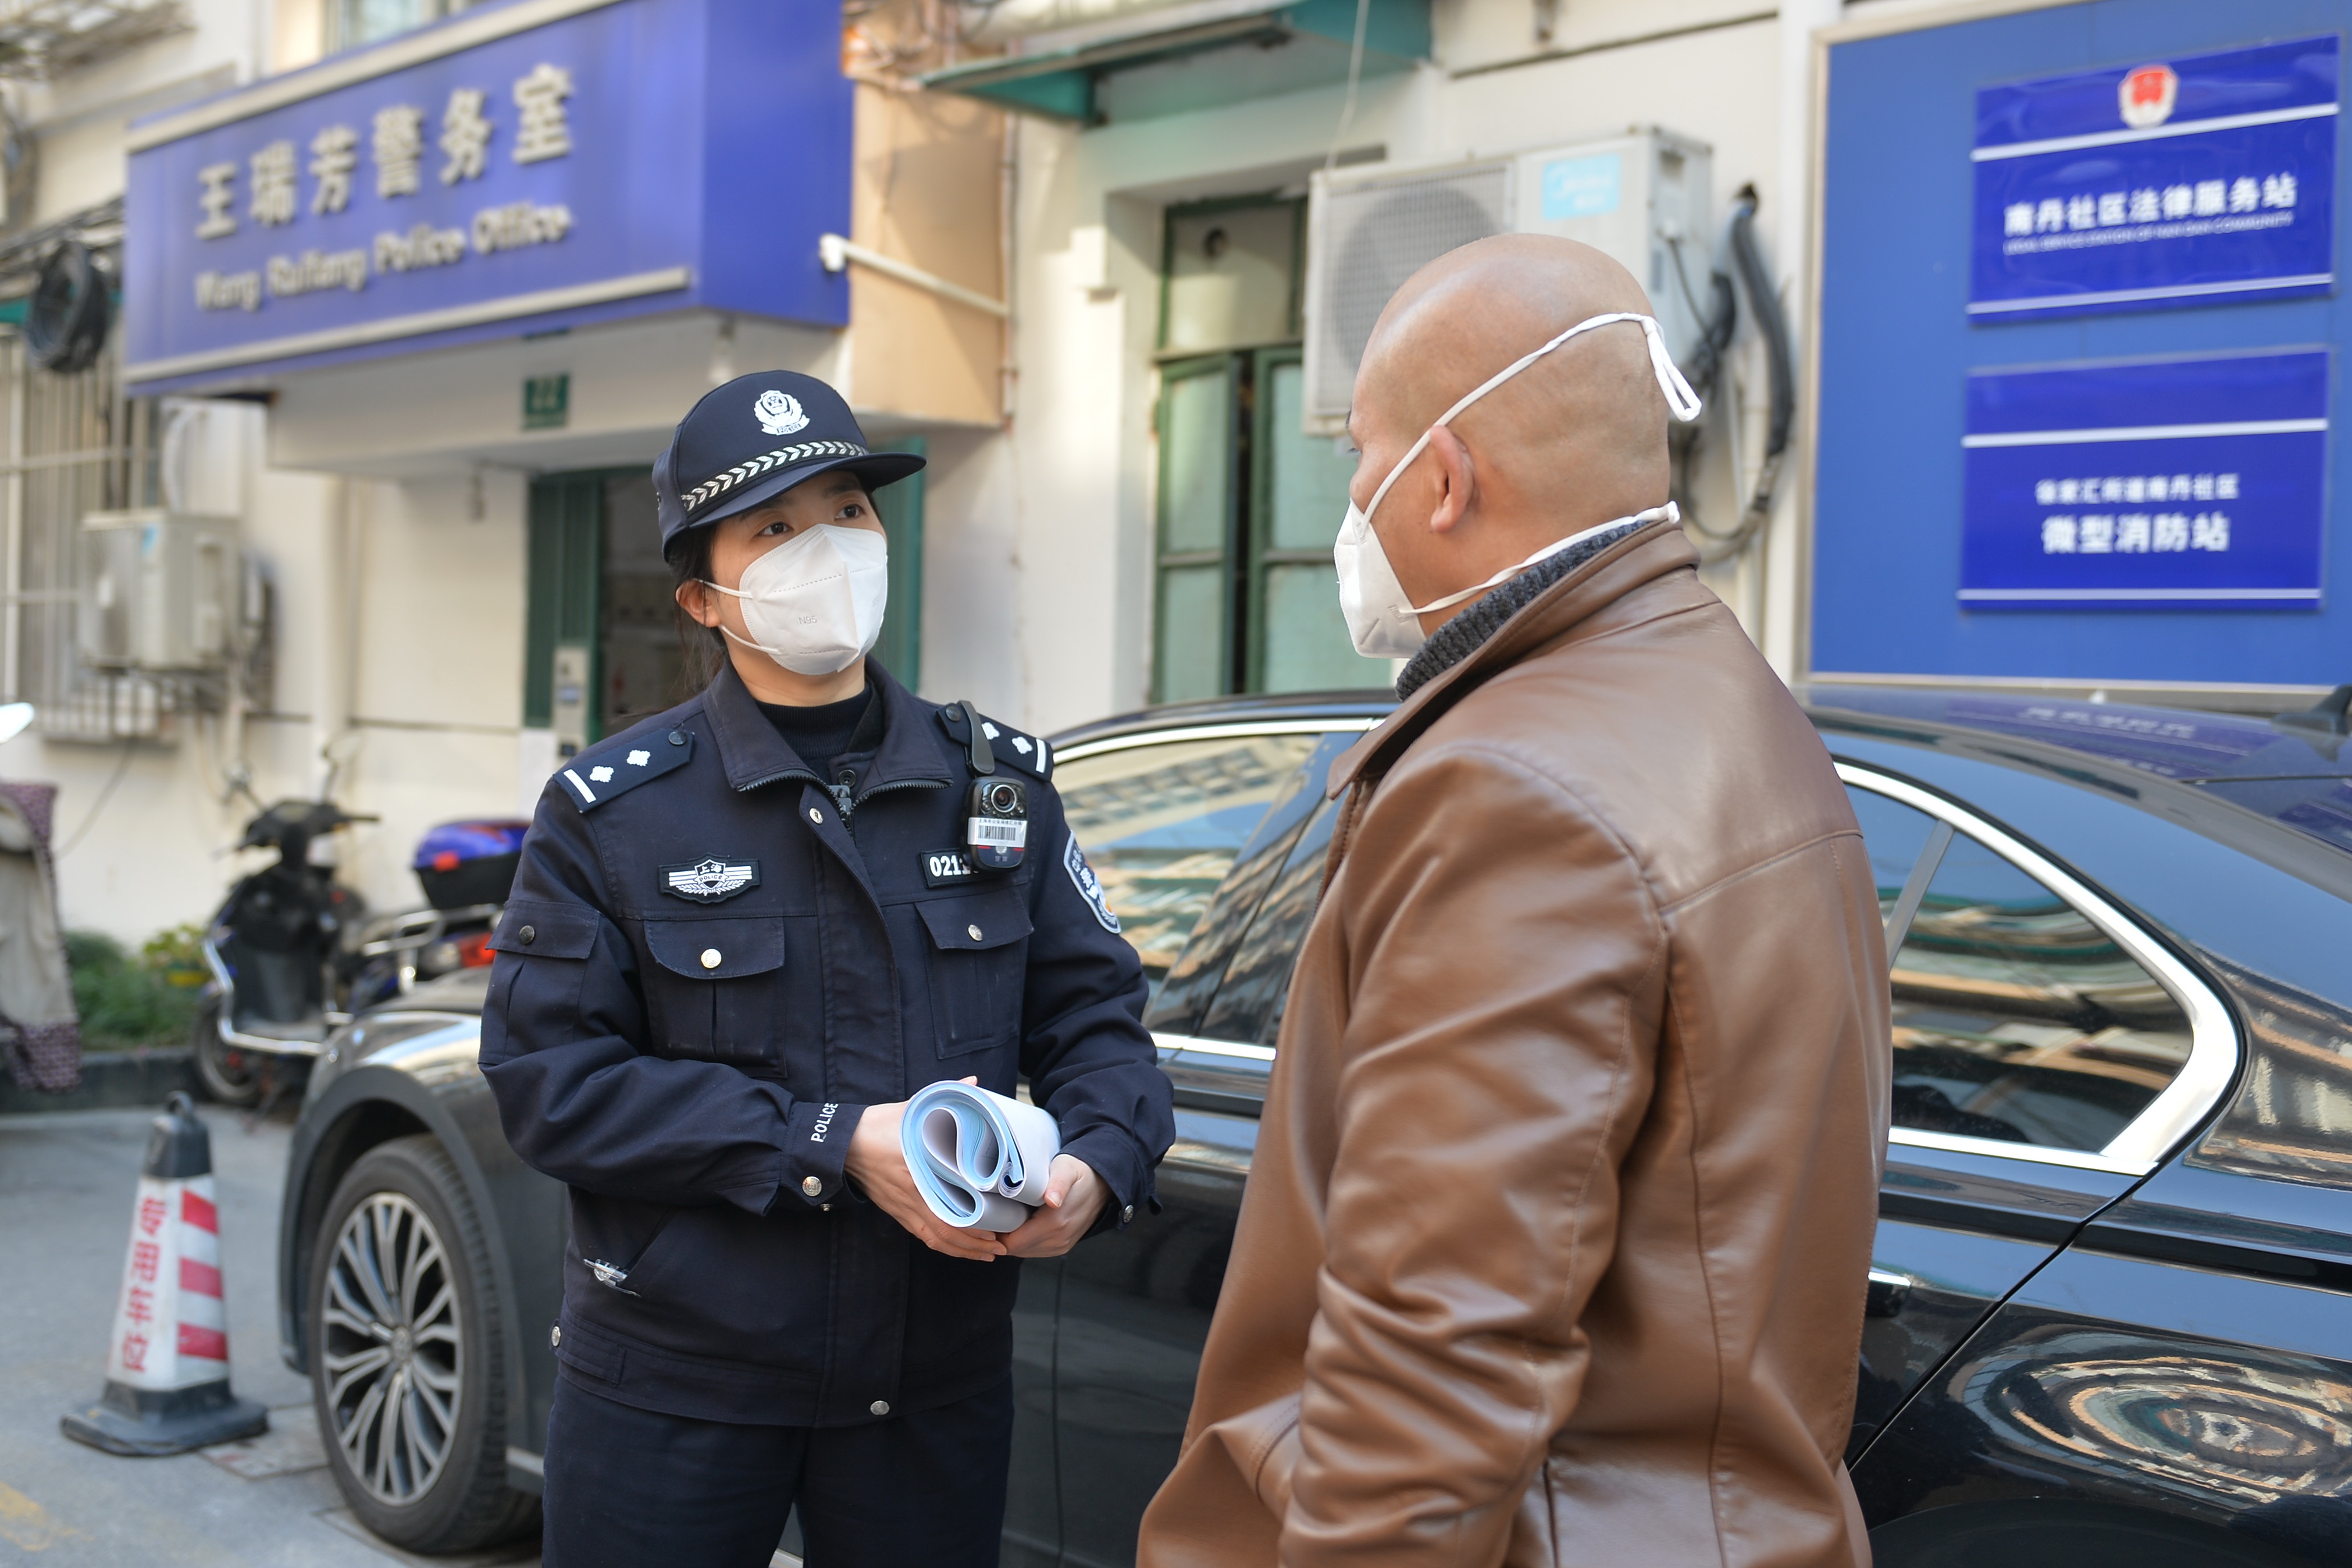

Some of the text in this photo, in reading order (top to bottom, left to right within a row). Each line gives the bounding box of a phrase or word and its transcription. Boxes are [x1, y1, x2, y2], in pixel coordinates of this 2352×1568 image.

[195, 63, 573, 240] 王瑞芳警务室
[2004, 170, 2297, 238] 南丹社区法律服务站
[2041, 511, 2231, 554] 微型消防站
[798, 615, 818, 625] N95
[700, 864, 722, 874] 上海
[811, 1103, 839, 1142] POLICE
